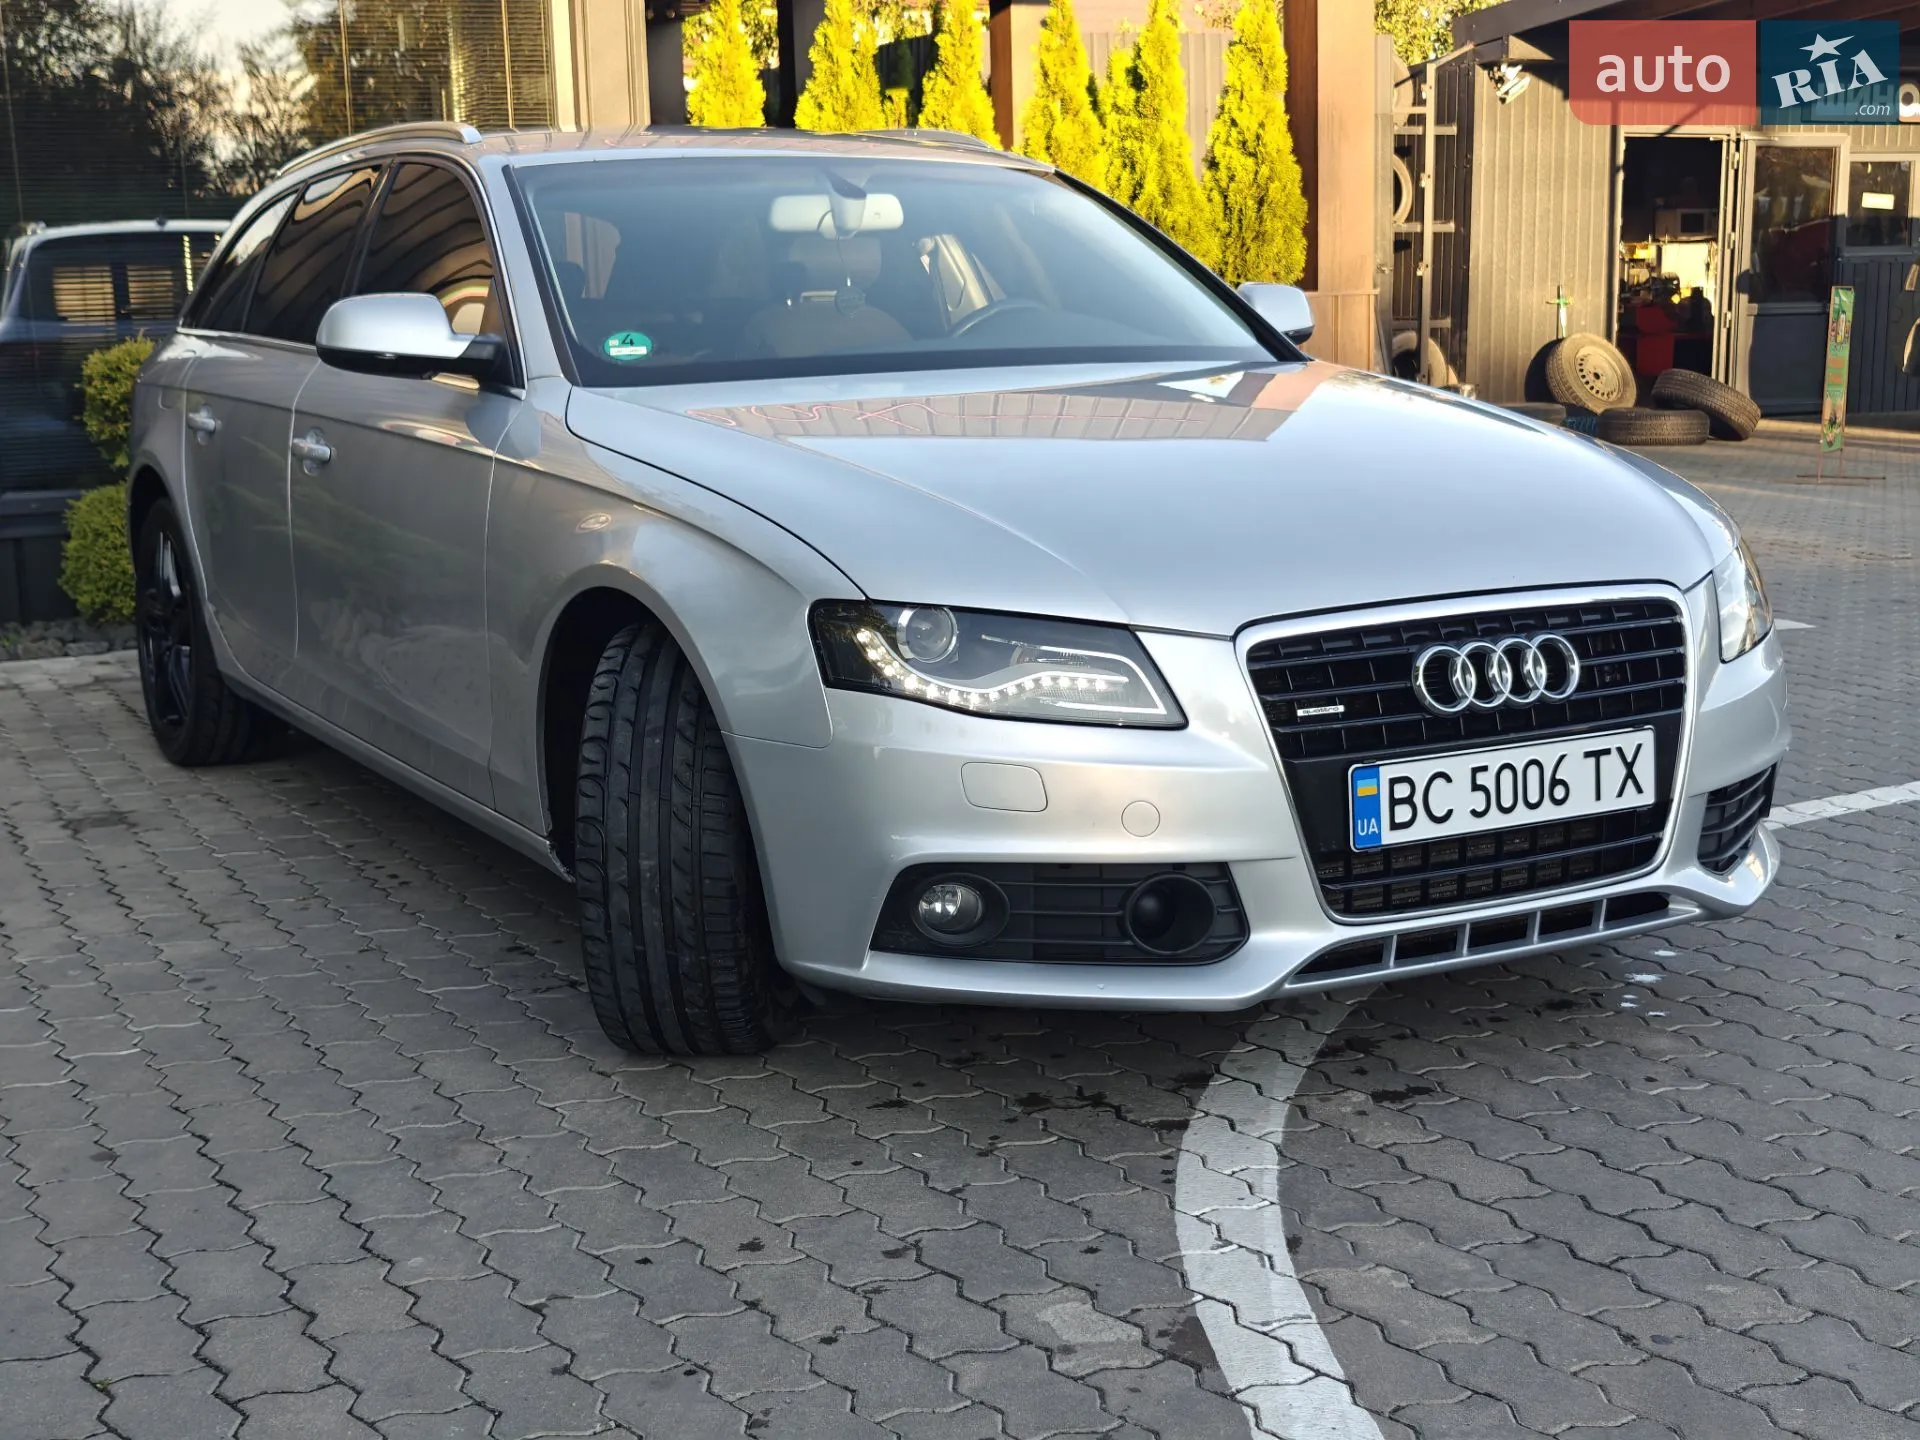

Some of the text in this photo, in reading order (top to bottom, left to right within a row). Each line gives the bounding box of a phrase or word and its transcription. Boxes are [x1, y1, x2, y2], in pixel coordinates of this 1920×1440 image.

[621, 333, 635, 346] 4
[1388, 743, 1644, 831] BC 5006 TX
[1357, 817, 1379, 836] UA
